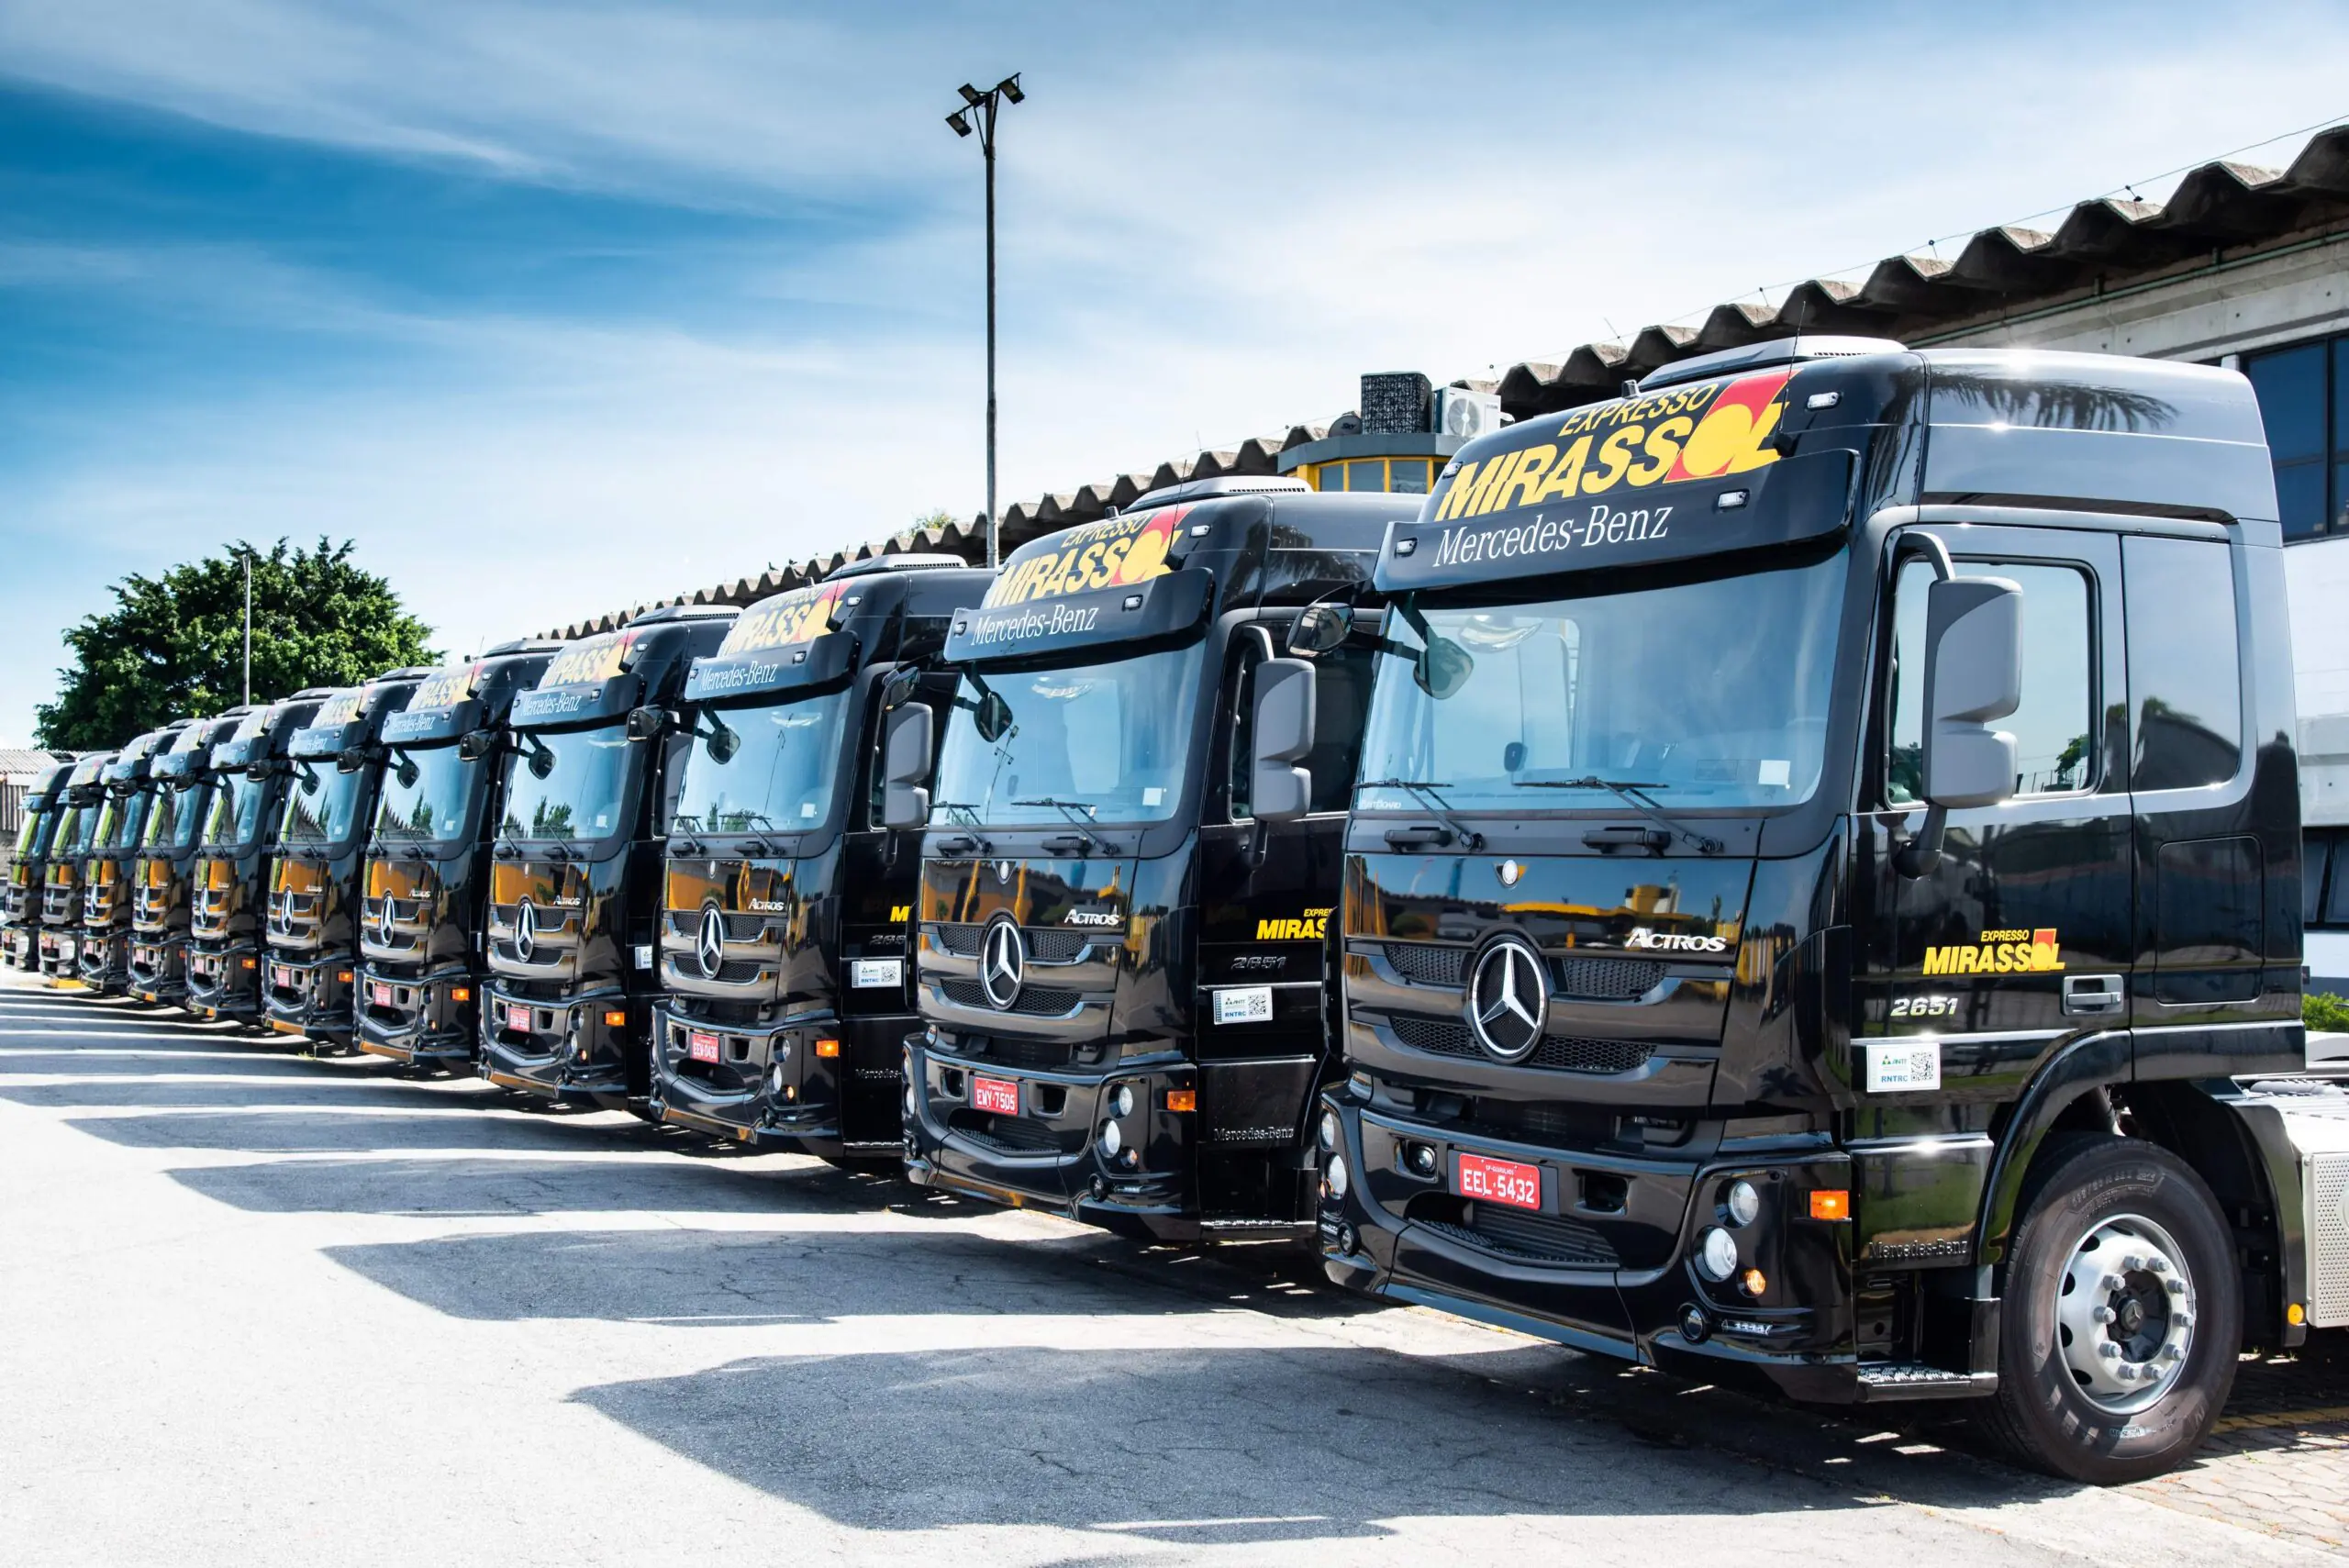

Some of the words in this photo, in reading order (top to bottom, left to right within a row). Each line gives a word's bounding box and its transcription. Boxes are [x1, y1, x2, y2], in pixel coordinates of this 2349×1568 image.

[1557, 383, 1720, 438] EXPRESSO
[1433, 400, 1790, 522] MIRASSOL
[1061, 513, 1152, 549] EXPRESSO
[1432, 504, 1675, 568] Mercedes-Benz
[987, 529, 1184, 609] MIRASSOL
[970, 604, 1099, 646] Mercedes-Benz
[698, 660, 778, 692] Mercedes-Benz
[519, 692, 582, 717] Mercedes-Benz
[1063, 908, 1119, 926] ACTROS
[1624, 928, 1727, 952] ACTROS
[1980, 929, 2030, 941] EXPRESSO
[1922, 943, 2065, 974] MIRASSOL
[1890, 996, 1958, 1017] 2651
[1881, 1074, 1909, 1084] RNTRC
[1213, 1126, 1295, 1142] Mercedes-Benz
[1868, 1237, 1968, 1259] Mercedes-Benz
